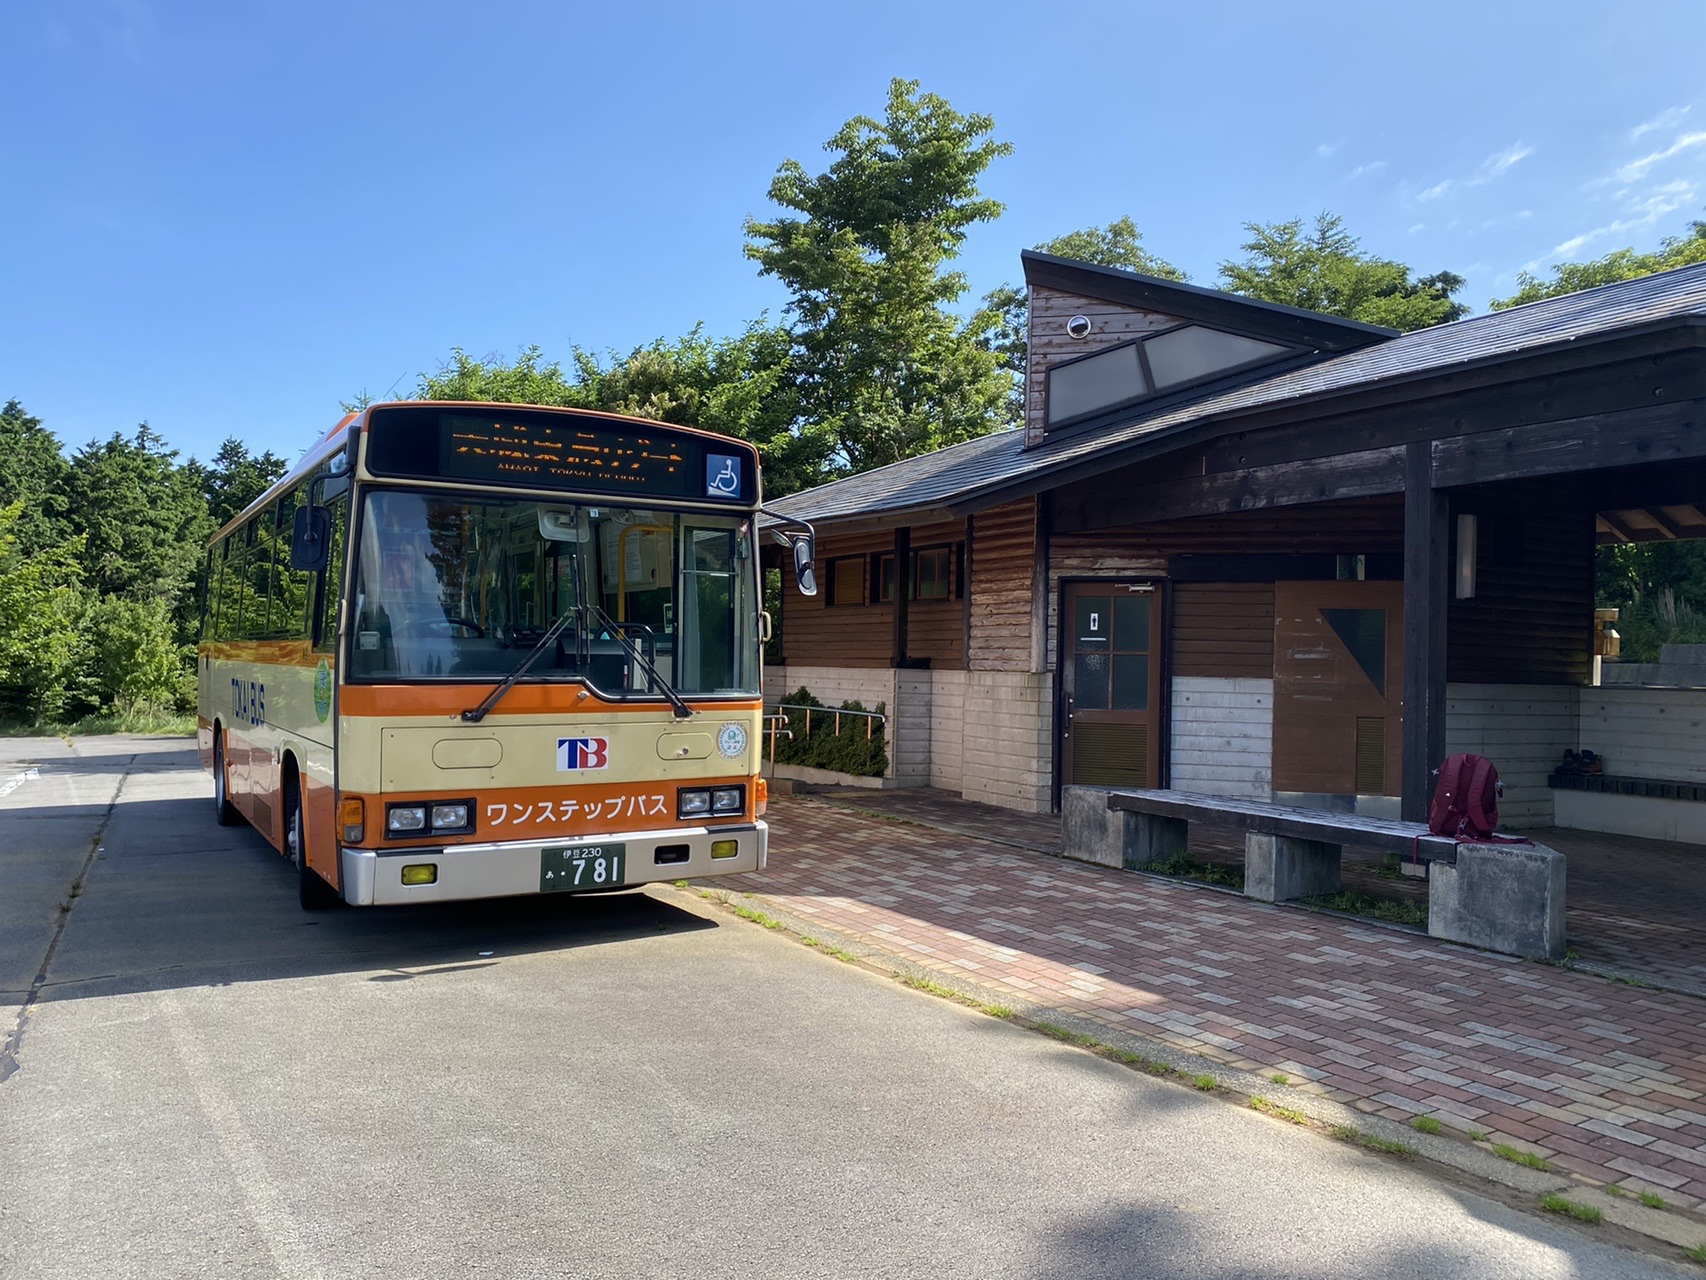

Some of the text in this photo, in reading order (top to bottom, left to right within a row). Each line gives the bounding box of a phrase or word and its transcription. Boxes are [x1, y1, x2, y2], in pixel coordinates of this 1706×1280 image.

[231, 678, 265, 728] TOKAI BUS
[557, 738, 608, 769] TB
[487, 795, 667, 825] ワンステップバス
[581, 847, 602, 858] 230
